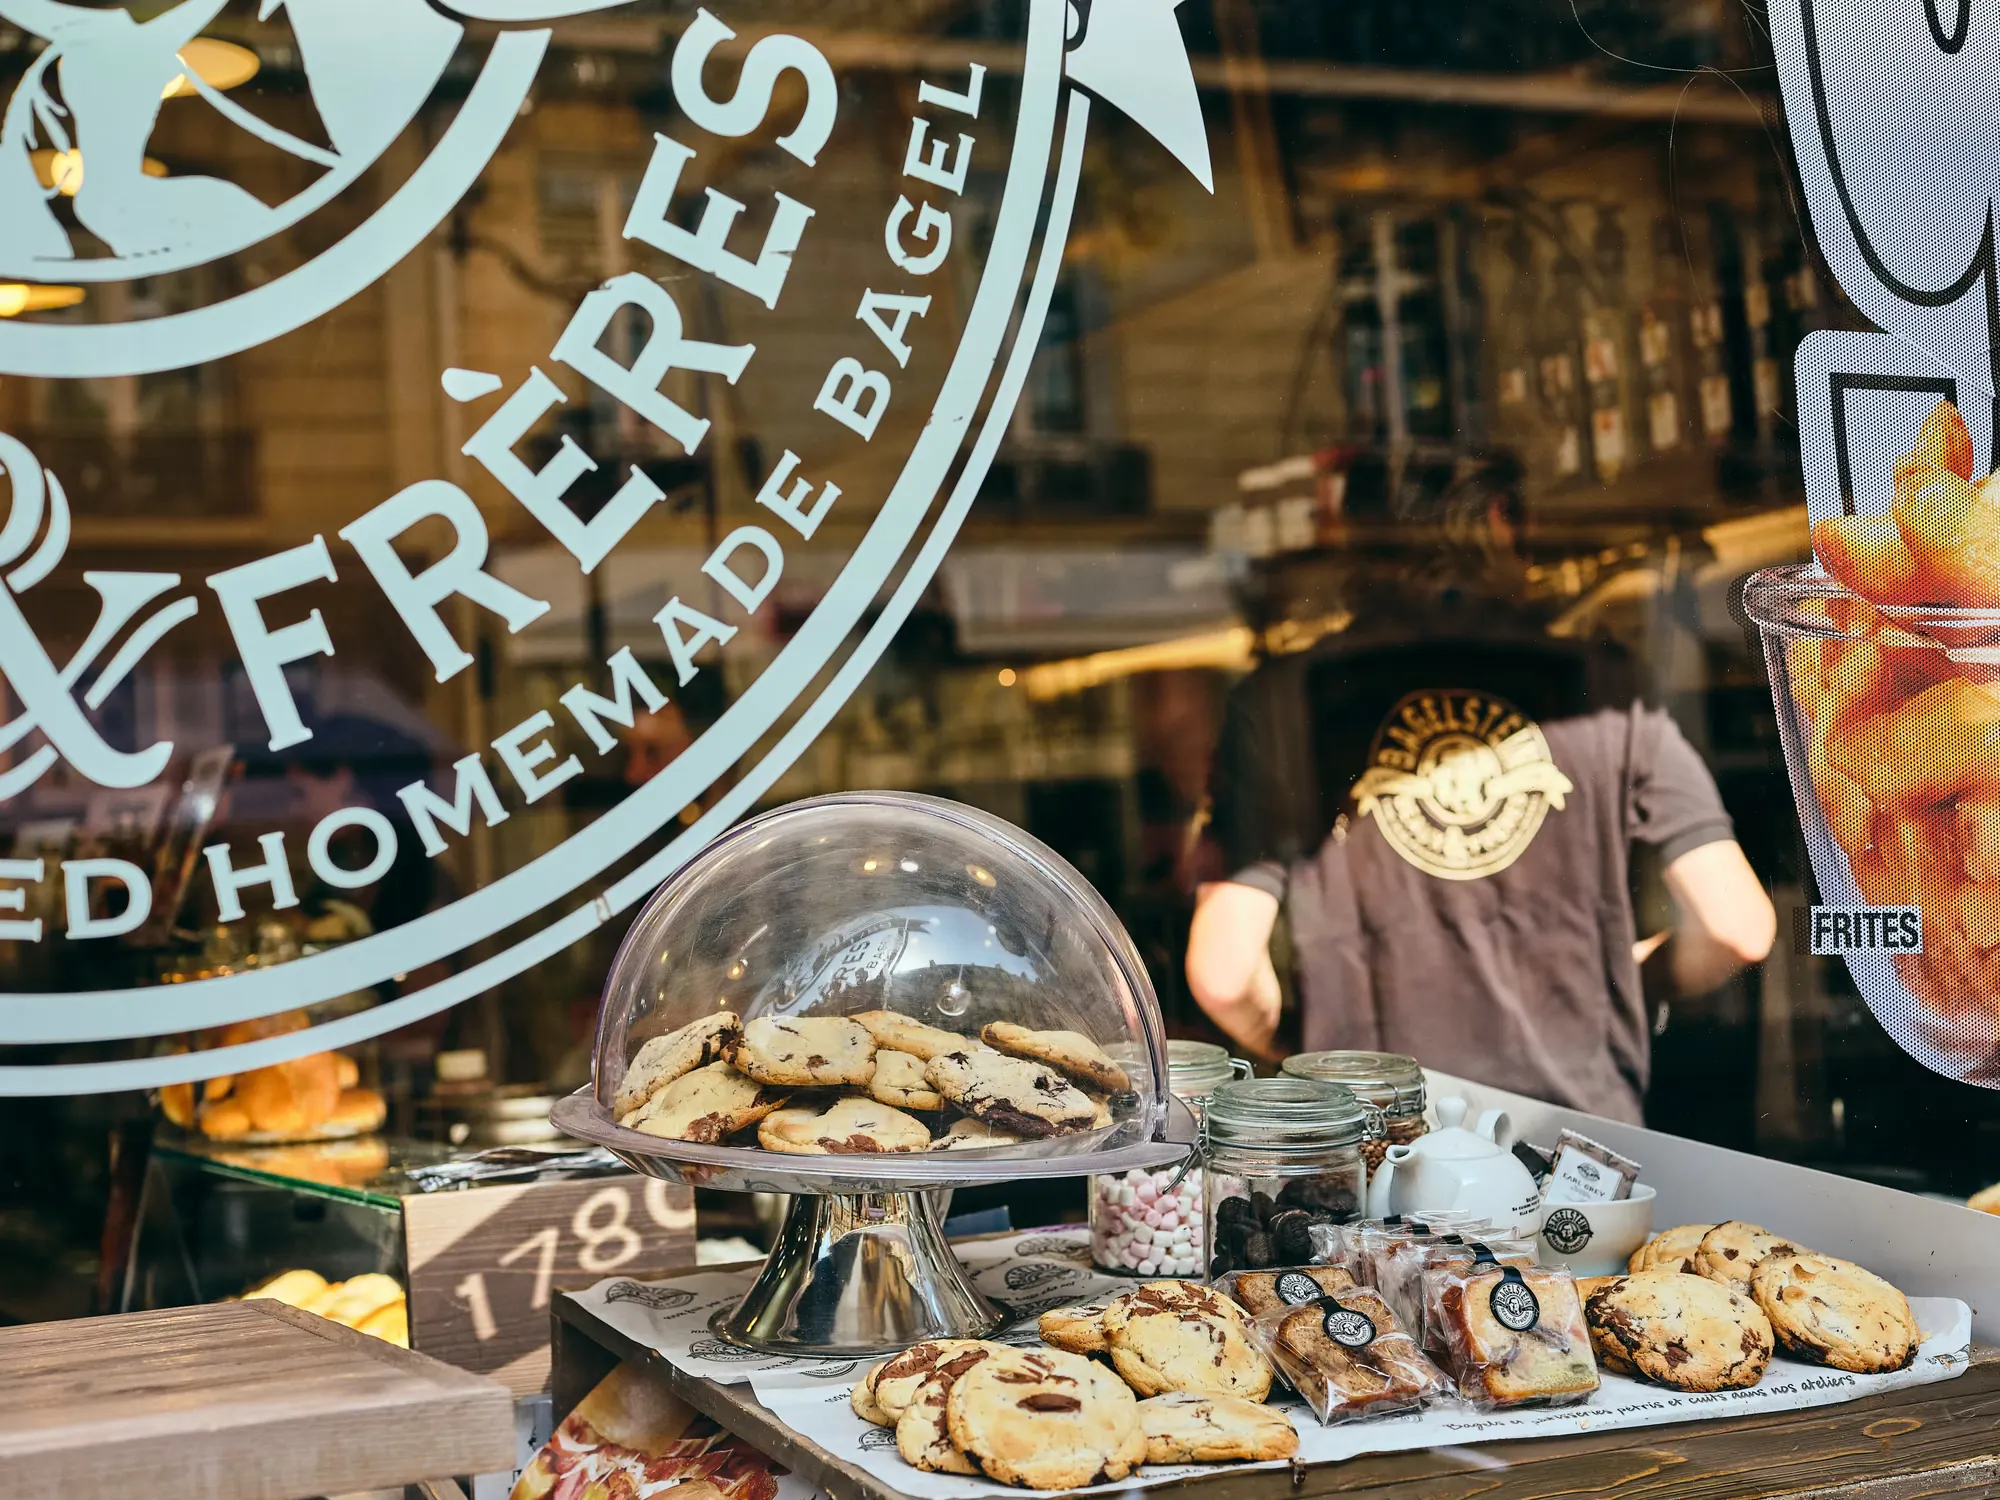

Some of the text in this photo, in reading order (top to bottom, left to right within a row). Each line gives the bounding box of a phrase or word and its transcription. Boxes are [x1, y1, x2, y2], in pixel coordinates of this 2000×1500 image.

[0, 8, 838, 799] & FRÈRES
[203, 449, 842, 922] HOMEMADE
[814, 62, 986, 441] BAGEL
[1815, 911, 1919, 949] FRITES
[1562, 1172, 1581, 1186] EARL
[1584, 1184, 1606, 1197] GREY
[1548, 1210, 1588, 1230] BAGELSTEIN
[1497, 1284, 1531, 1305] BAGELSTEIN
[1329, 1313, 1363, 1332] BAGELSTEIN
[1668, 1398, 1682, 1407] et
[1689, 1393, 1727, 1405] cuits
[1731, 1388, 1767, 1401] dans
[1771, 1382, 1798, 1395] nos
[1801, 1373, 1856, 1391] ateliers
